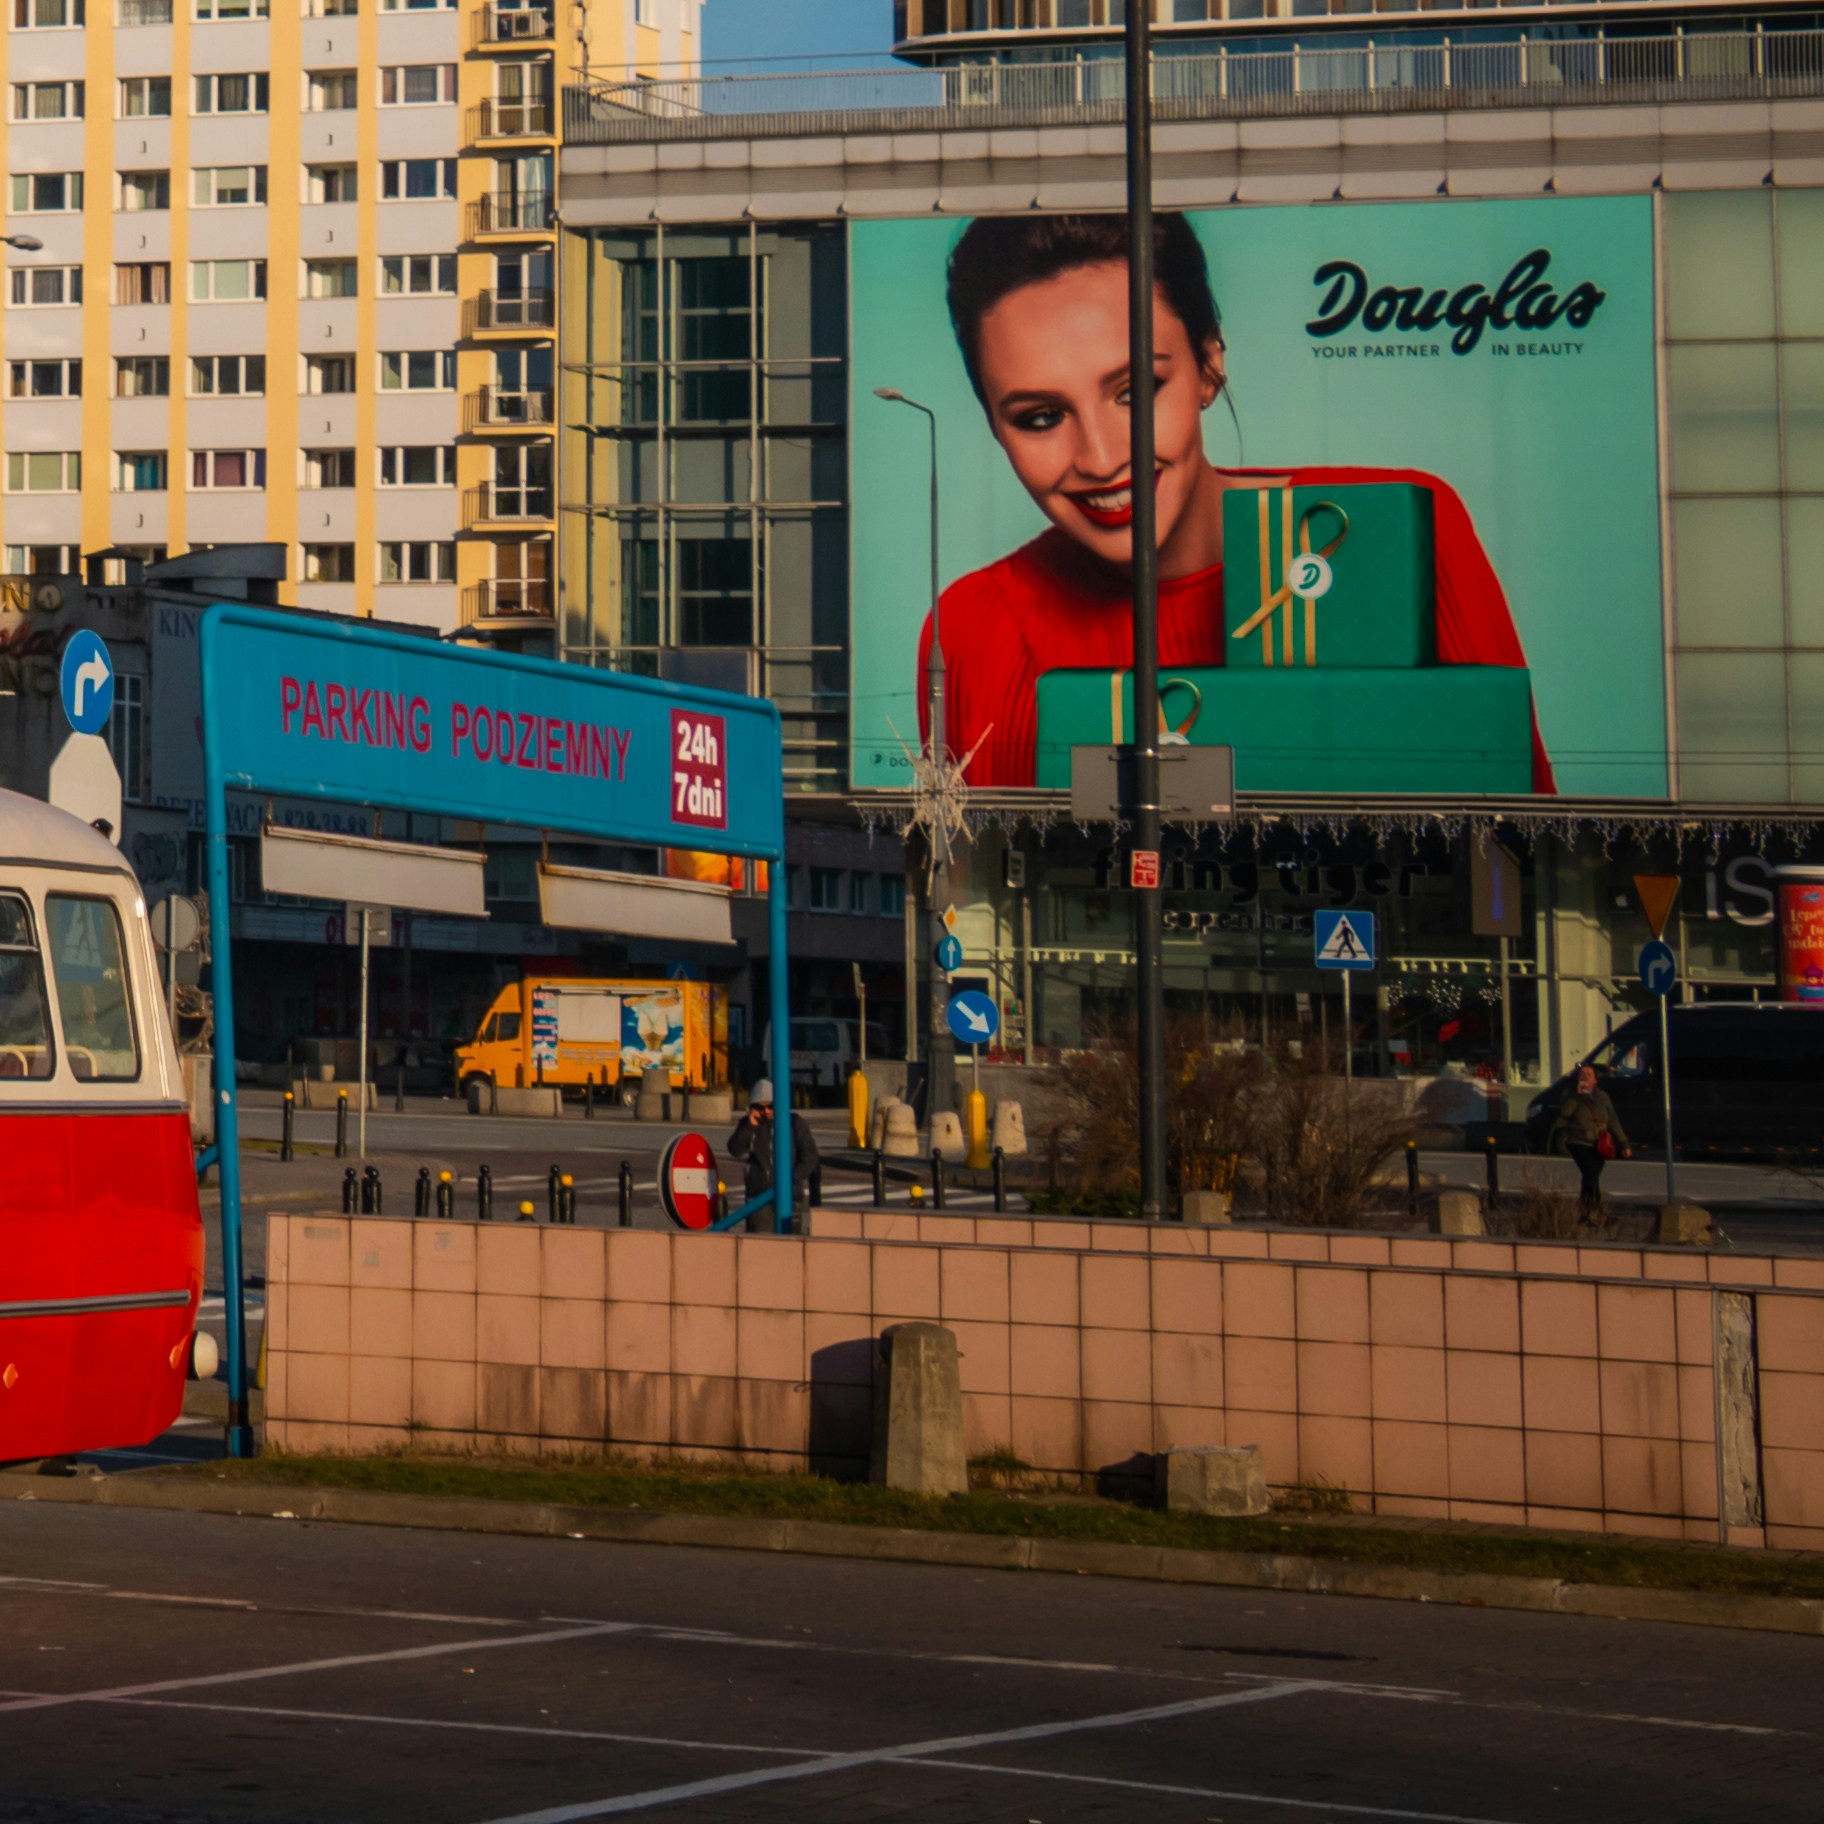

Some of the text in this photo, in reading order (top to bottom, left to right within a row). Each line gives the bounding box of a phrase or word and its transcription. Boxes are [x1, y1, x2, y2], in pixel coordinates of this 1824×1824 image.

[1305, 248, 1606, 356] Douglas
[1312, 342, 1584, 358] YOUR PARTNER IN BEAUTY
[281, 676, 631, 780] PARKING PODZIEMNY
[678, 719, 719, 765] 24h
[674, 771, 724, 818] 7dni
